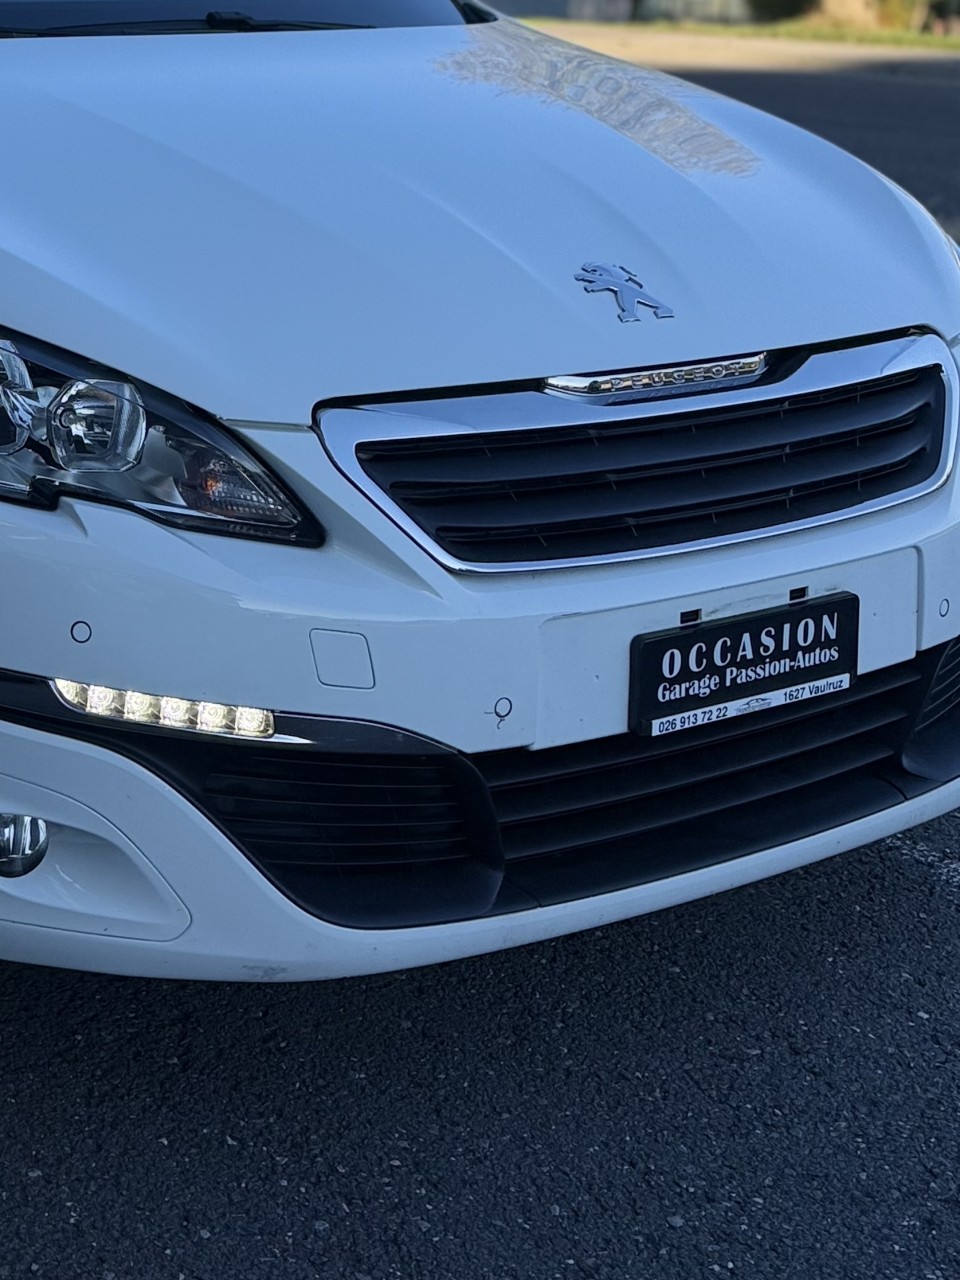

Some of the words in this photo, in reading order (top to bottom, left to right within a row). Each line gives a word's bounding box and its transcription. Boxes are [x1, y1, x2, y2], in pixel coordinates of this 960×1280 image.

[610, 361, 743, 391] PEUGEOT
[661, 611, 839, 679] OCCASION
[657, 673, 720, 703] Garage
[725, 645, 839, 687] Passion-Autos
[658, 715, 677, 733] 026
[679, 711, 698, 728] 913
[700, 709, 714, 724] 72
[716, 706, 728, 720] 22
[783, 687, 805, 702] 1627
[808, 679, 844, 698] Vaulruz
